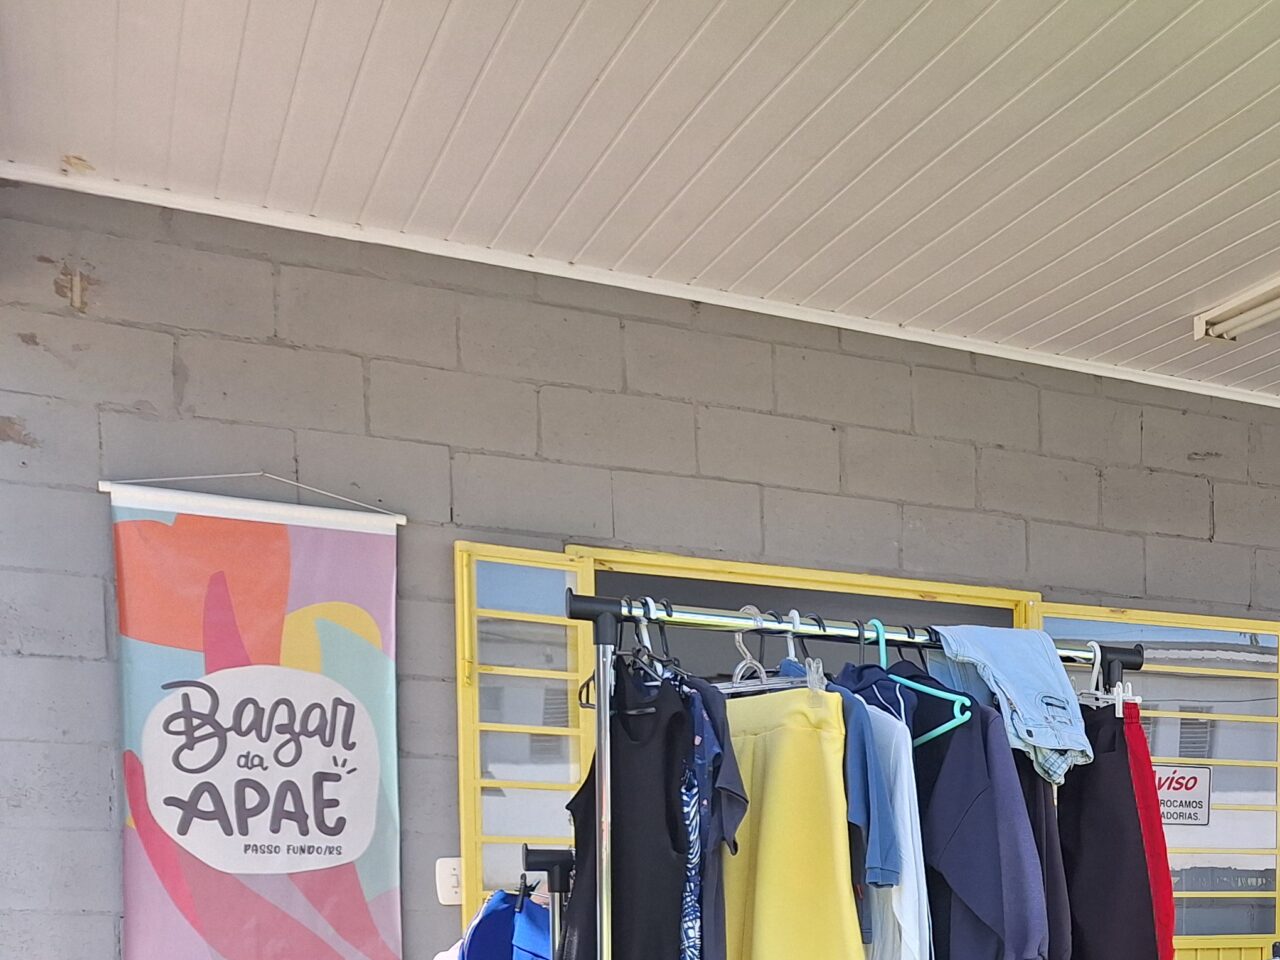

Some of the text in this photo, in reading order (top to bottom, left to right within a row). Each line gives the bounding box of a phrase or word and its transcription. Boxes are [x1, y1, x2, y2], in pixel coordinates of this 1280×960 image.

[161, 680, 356, 774] Bazar
[237, 751, 269, 770] da
[1153, 769, 1198, 791] viso
[163, 771, 347, 836] APAE
[1160, 799, 1204, 809] ROCAMOS
[1161, 811, 1201, 821] ADORIAS.
[243, 844, 343, 855] PASSO FUNDO/RS
